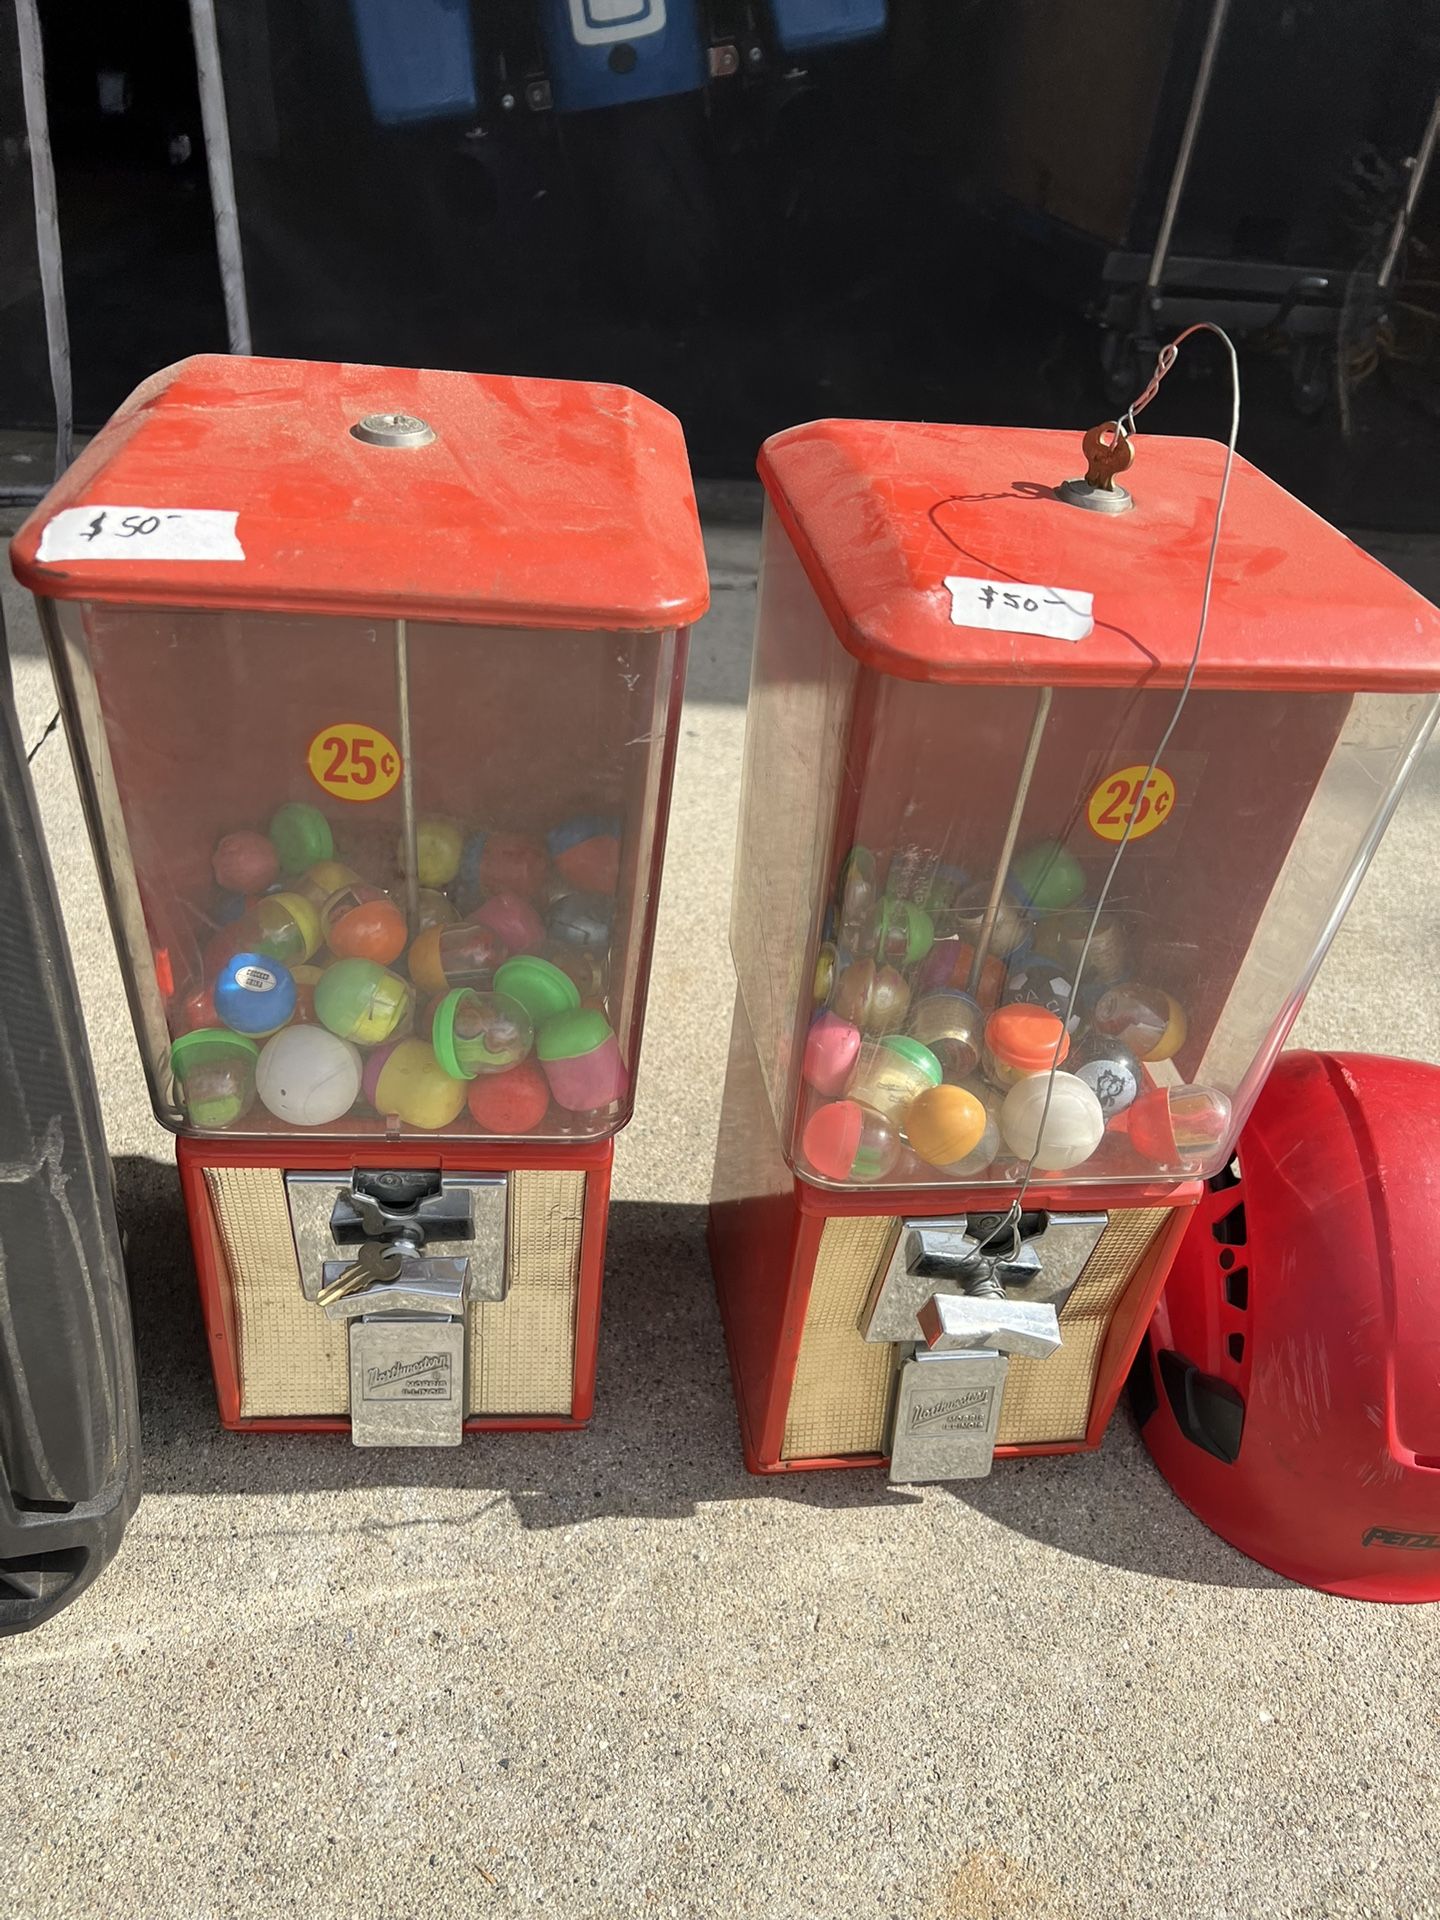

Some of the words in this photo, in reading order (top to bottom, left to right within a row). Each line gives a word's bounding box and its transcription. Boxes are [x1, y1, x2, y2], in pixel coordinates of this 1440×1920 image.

[322, 736, 395, 785] 25¢
[367, 1354, 449, 1386] Northwestern
[911, 1389, 989, 1424] Northwestern
